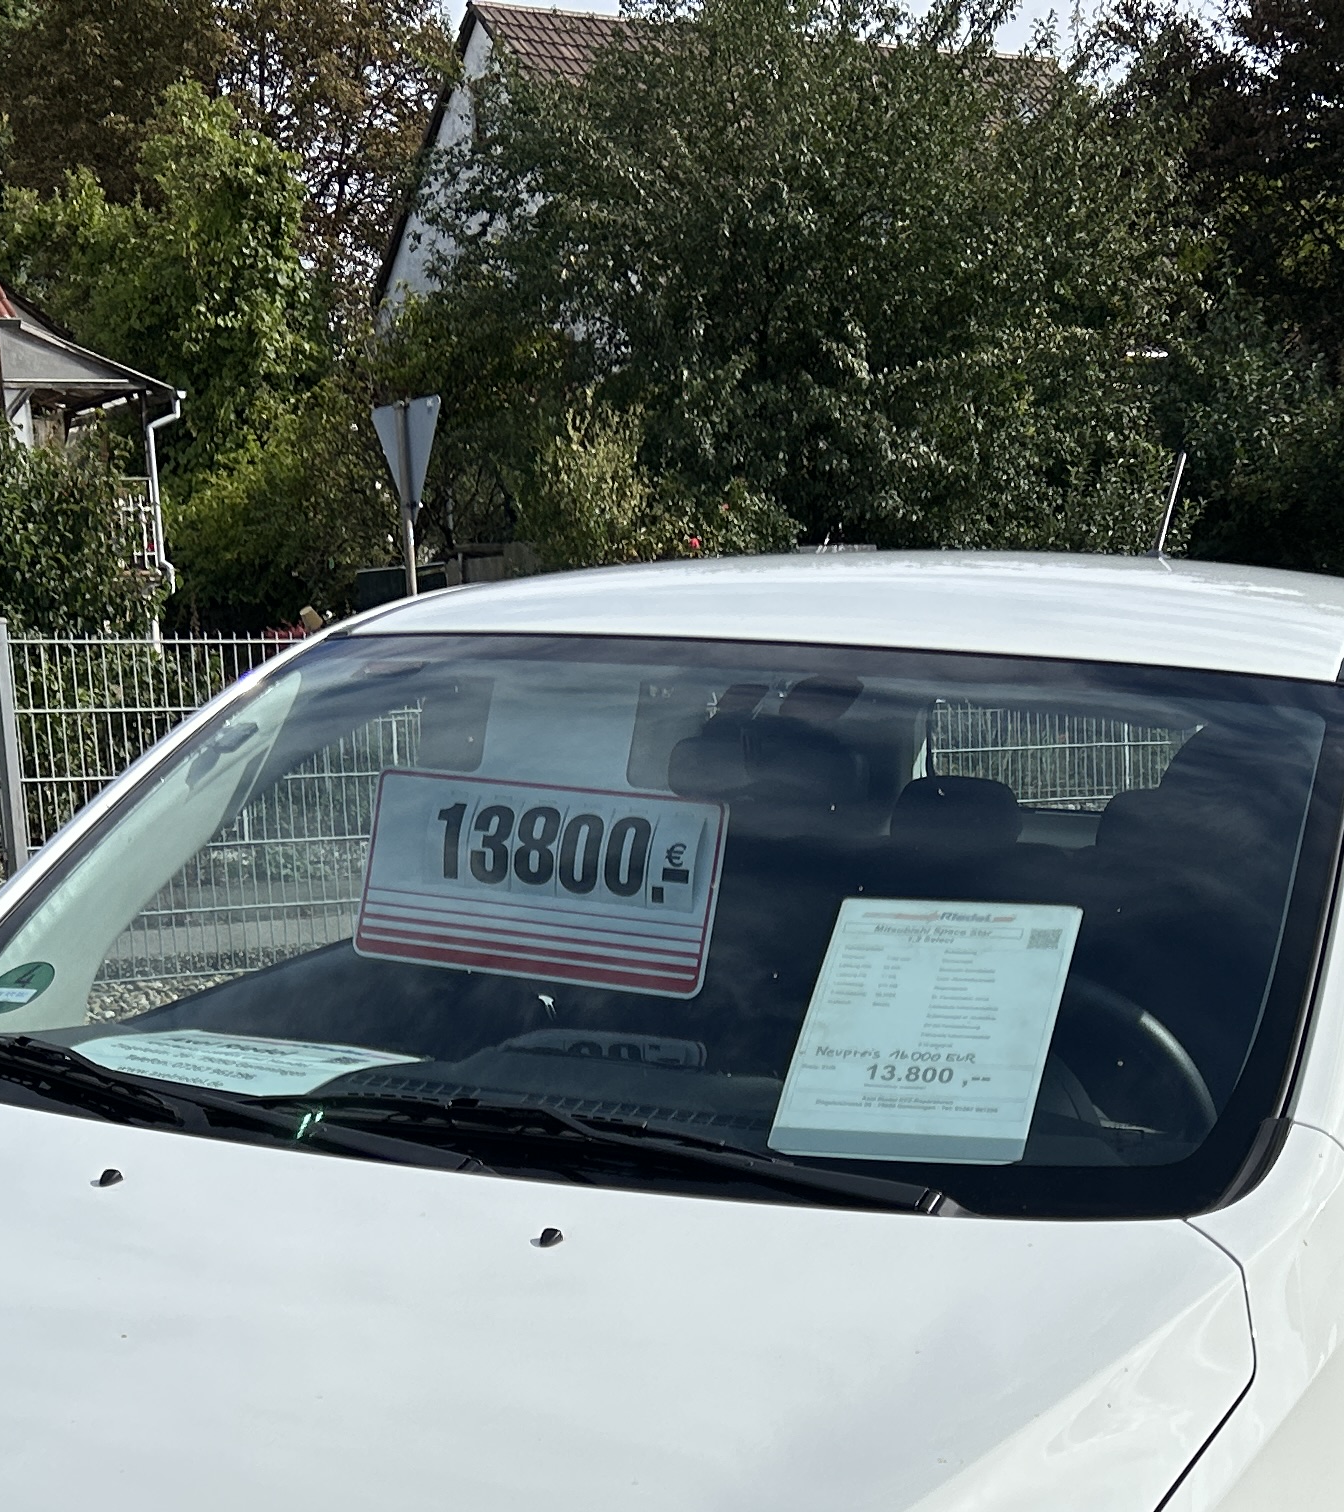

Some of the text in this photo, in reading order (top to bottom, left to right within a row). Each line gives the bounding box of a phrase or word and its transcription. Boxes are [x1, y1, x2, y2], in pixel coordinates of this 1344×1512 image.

[874, 924, 993, 938] Mitsubishi Space Star
[15, 964, 42, 988] 4
[816, 1046, 881, 1060] Neupreis
[946, 1052, 977, 1064] EUR
[866, 1063, 954, 1084] 13.800
